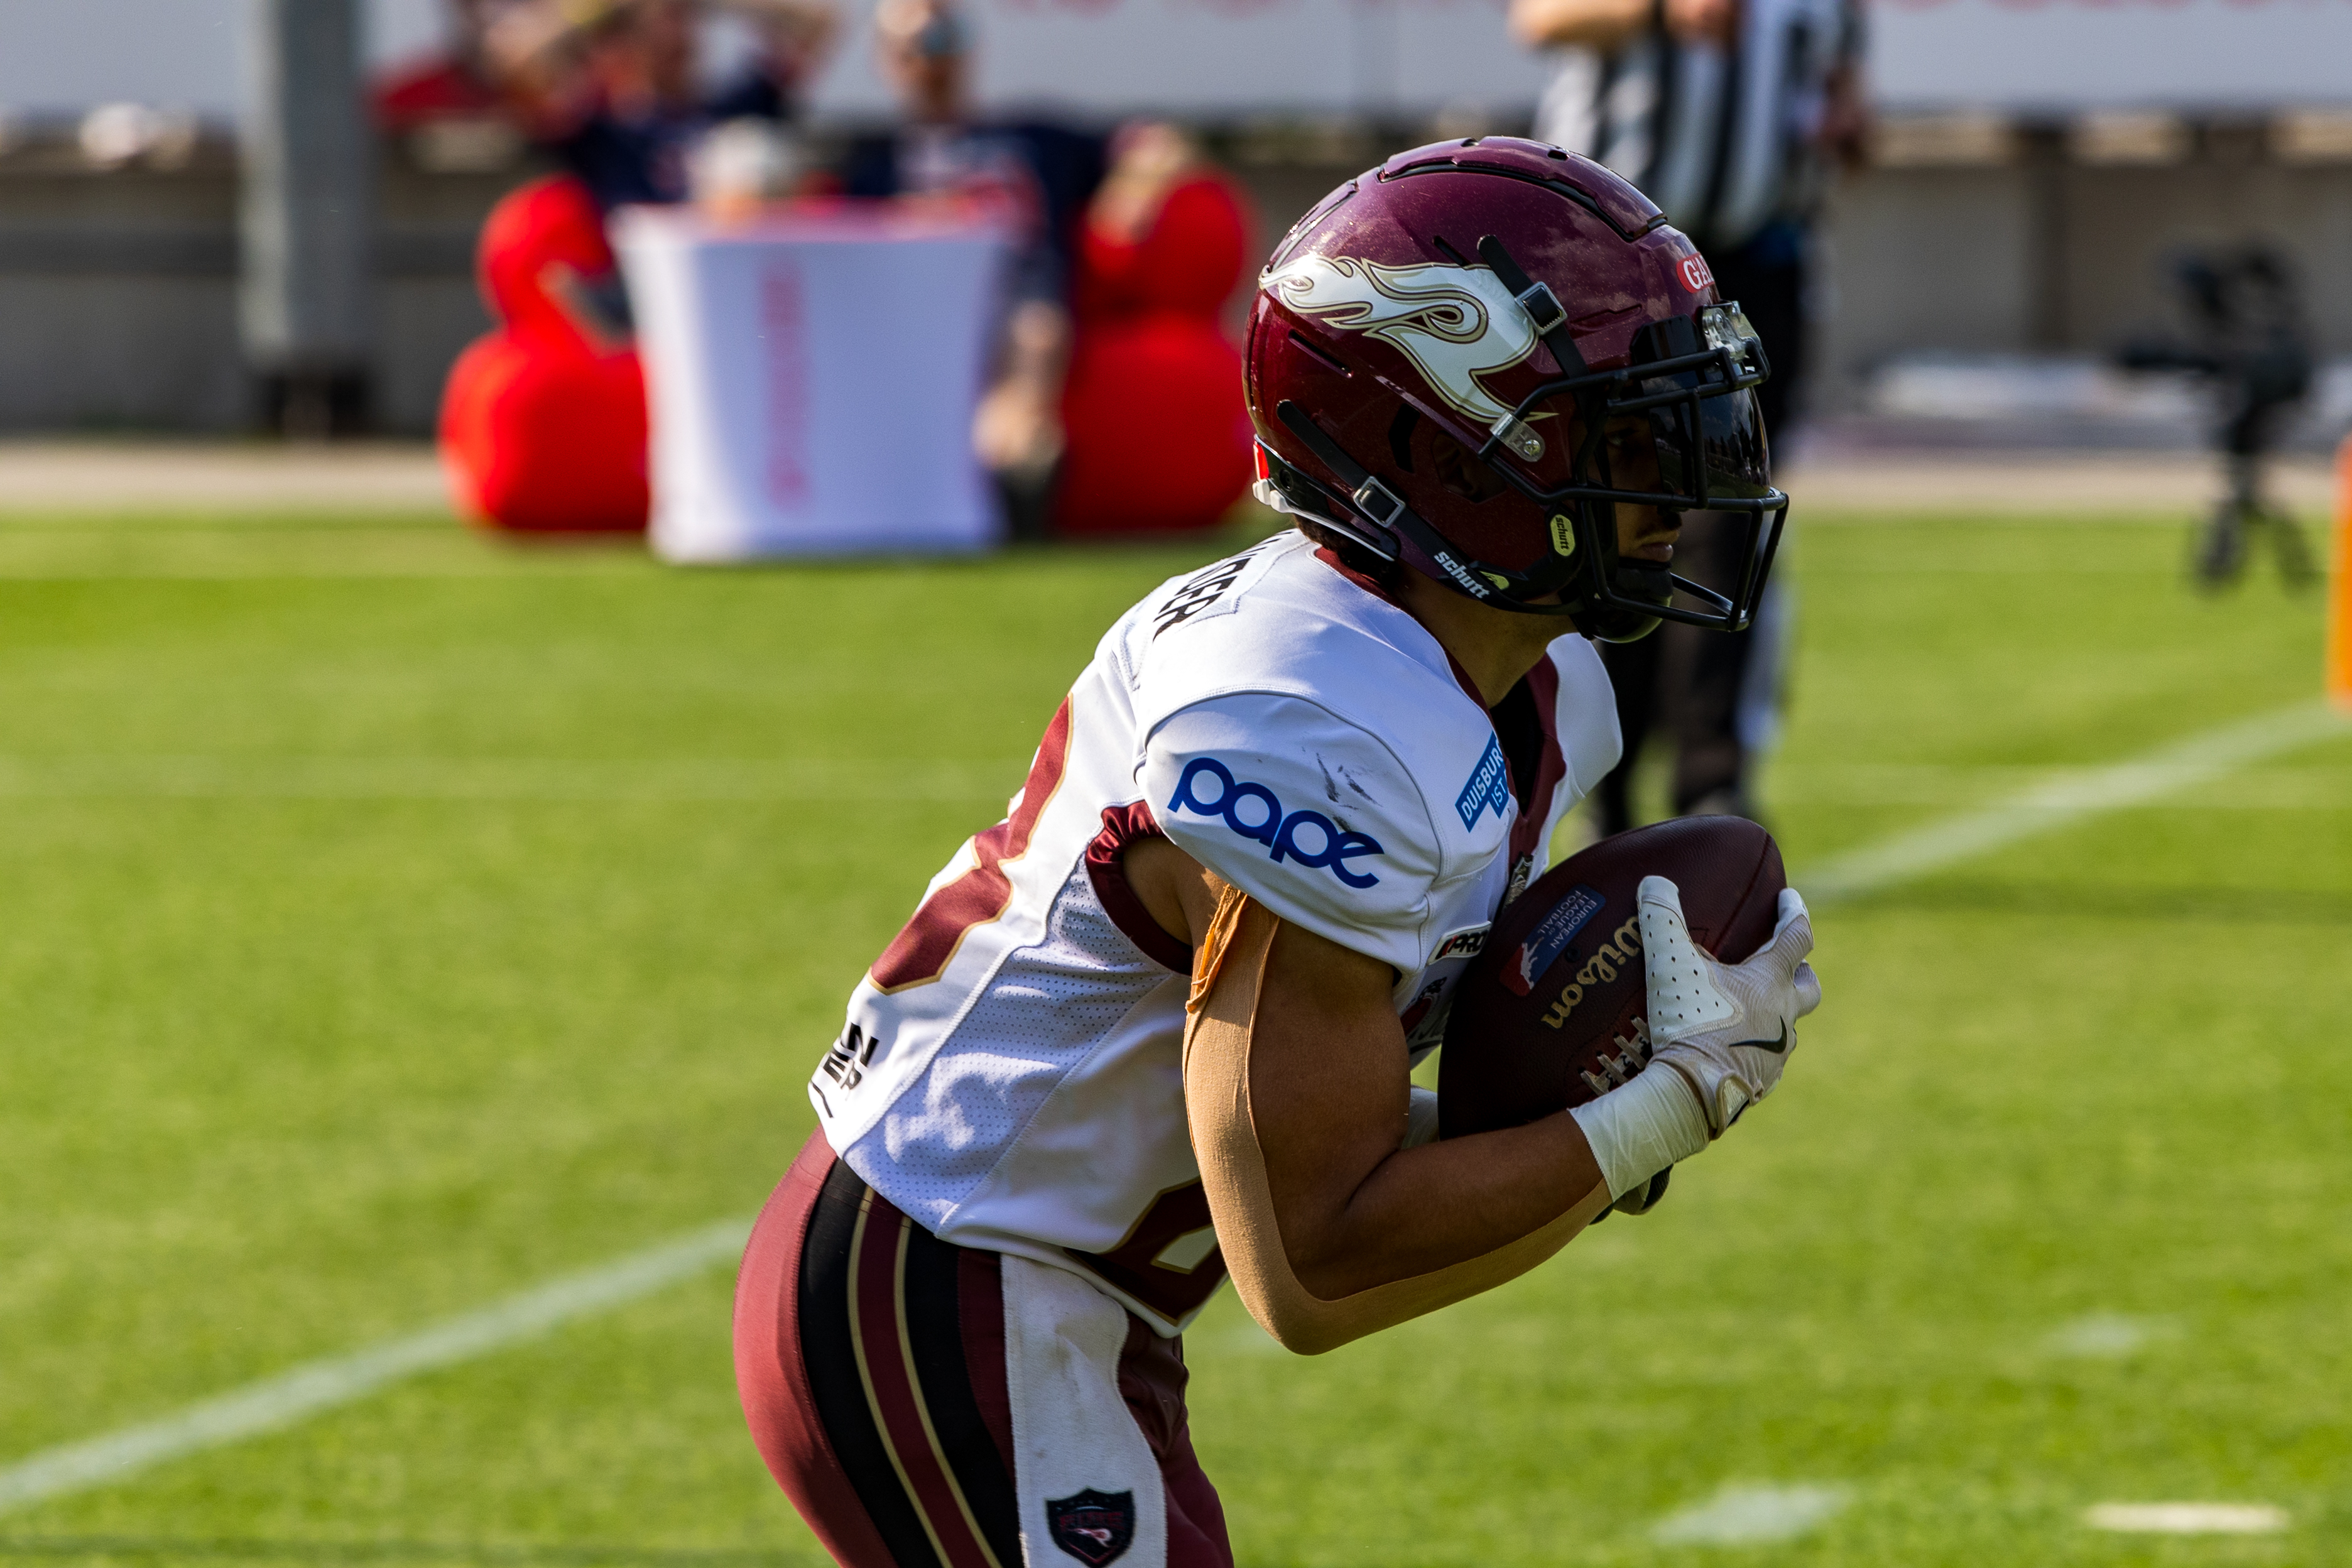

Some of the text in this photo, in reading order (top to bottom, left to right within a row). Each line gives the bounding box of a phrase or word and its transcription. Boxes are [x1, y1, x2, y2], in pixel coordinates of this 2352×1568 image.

[1555, 516, 1570, 550] schutt
[1434, 551, 1490, 599] schutt
[1491, 776, 1506, 808] IST
[1167, 757, 1385, 889] pape
[1537, 890, 1582, 934] FOOTBALL
[1549, 899, 1598, 949] EUROPEAN
[1555, 894, 1590, 930] LEAGUE
